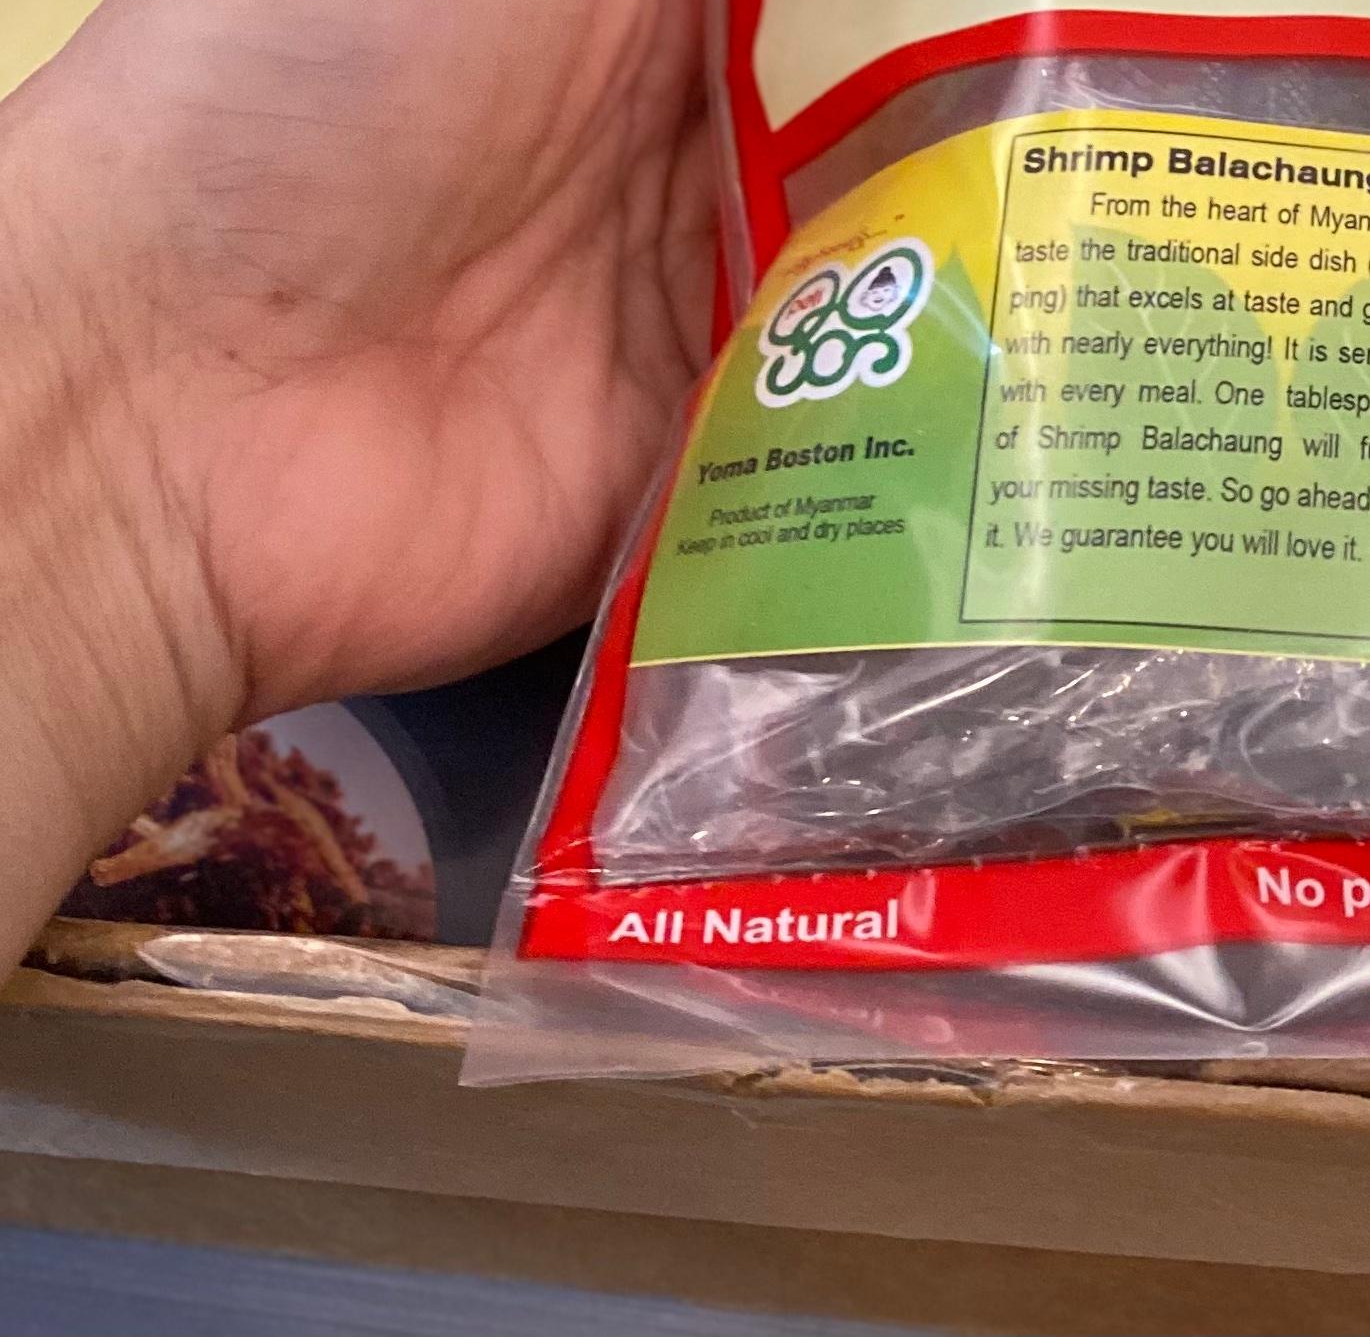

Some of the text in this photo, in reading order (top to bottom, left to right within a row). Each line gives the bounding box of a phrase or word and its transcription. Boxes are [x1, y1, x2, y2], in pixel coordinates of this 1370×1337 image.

[1024, 147, 1153, 178] Shrimp
[1090, 193, 1150, 218] From
[1162, 195, 1196, 218] the
[1208, 198, 1267, 223] heart
[1278, 204, 1300, 226] of
[1015, 240, 1069, 262] taste
[1081, 240, 1115, 261] the
[1127, 241, 1240, 266] traditional
[1251, 247, 1298, 269] side
[1309, 249, 1356, 273] dish
[1010, 287, 1067, 315] ping)
[1076, 286, 1119, 308] that
[1128, 287, 1202, 310] excels
[1213, 293, 1235, 312] at
[1244, 295, 1300, 315] taste
[1309, 297, 1353, 319] and
[1005, 333, 1050, 354] with
[1061, 334, 1132, 359] nearly
[1144, 336, 1273, 363] everything!
[1284, 338, 1298, 360] It
[1309, 342, 1327, 362] is
[1000, 379, 1046, 403] with
[1061, 383, 1125, 408] every
[1138, 382, 1202, 404] meal.
[1215, 382, 1264, 406] One
[995, 426, 1020, 449] of
[1038, 426, 1121, 453] Shrimp
[1141, 427, 1283, 460] Balachaung
[1302, 434, 1339, 457] will
[698, 436, 915, 484] Yoma Boston Inc.
[990, 477, 1042, 504] your
[1049, 475, 1139, 504] missing
[1148, 477, 1209, 502] taste.
[1221, 478, 1253, 503] So
[1260, 483, 1289, 510] go
[710, 495, 876, 526] Product of Myanmar
[1014, 523, 1053, 546] We
[1061, 527, 1183, 552] guarantee
[1190, 531, 1234, 556] you
[1243, 532, 1278, 555] will
[1287, 537, 1335, 559] love
[1344, 538, 1362, 561] it.
[1255, 866, 1325, 907] No
[608, 899, 899, 944] All Natural
